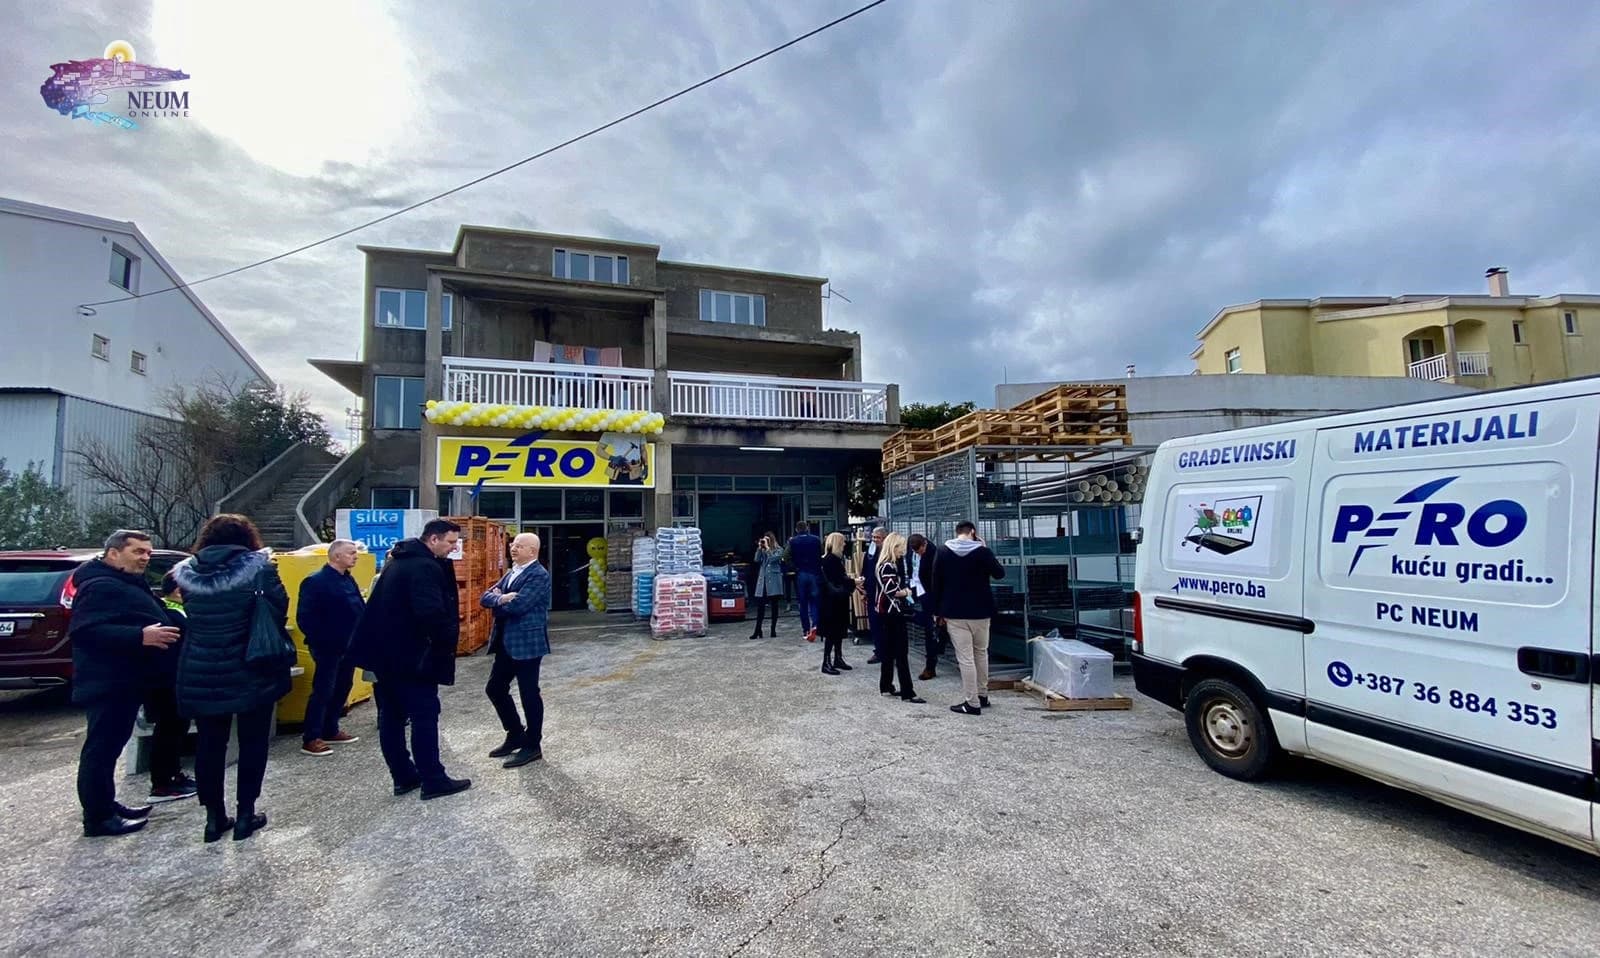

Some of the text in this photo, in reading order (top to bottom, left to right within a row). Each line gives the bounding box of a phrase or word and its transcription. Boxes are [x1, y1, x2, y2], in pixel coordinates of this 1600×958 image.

[1354, 411, 1539, 453] MATERIJALI
[455, 431, 596, 486] PERO
[1178, 439, 1297, 469] GRAĐEVINSKI
[356, 510, 399, 523] silka
[1332, 476, 1529, 562] PERO
[1391, 554, 1554, 584] kuću gradi...
[1178, 576, 1266, 598] www.pero.ba
[1376, 603, 1479, 632] PC NEUM
[1354, 672, 1558, 729] +387 36 884 353
